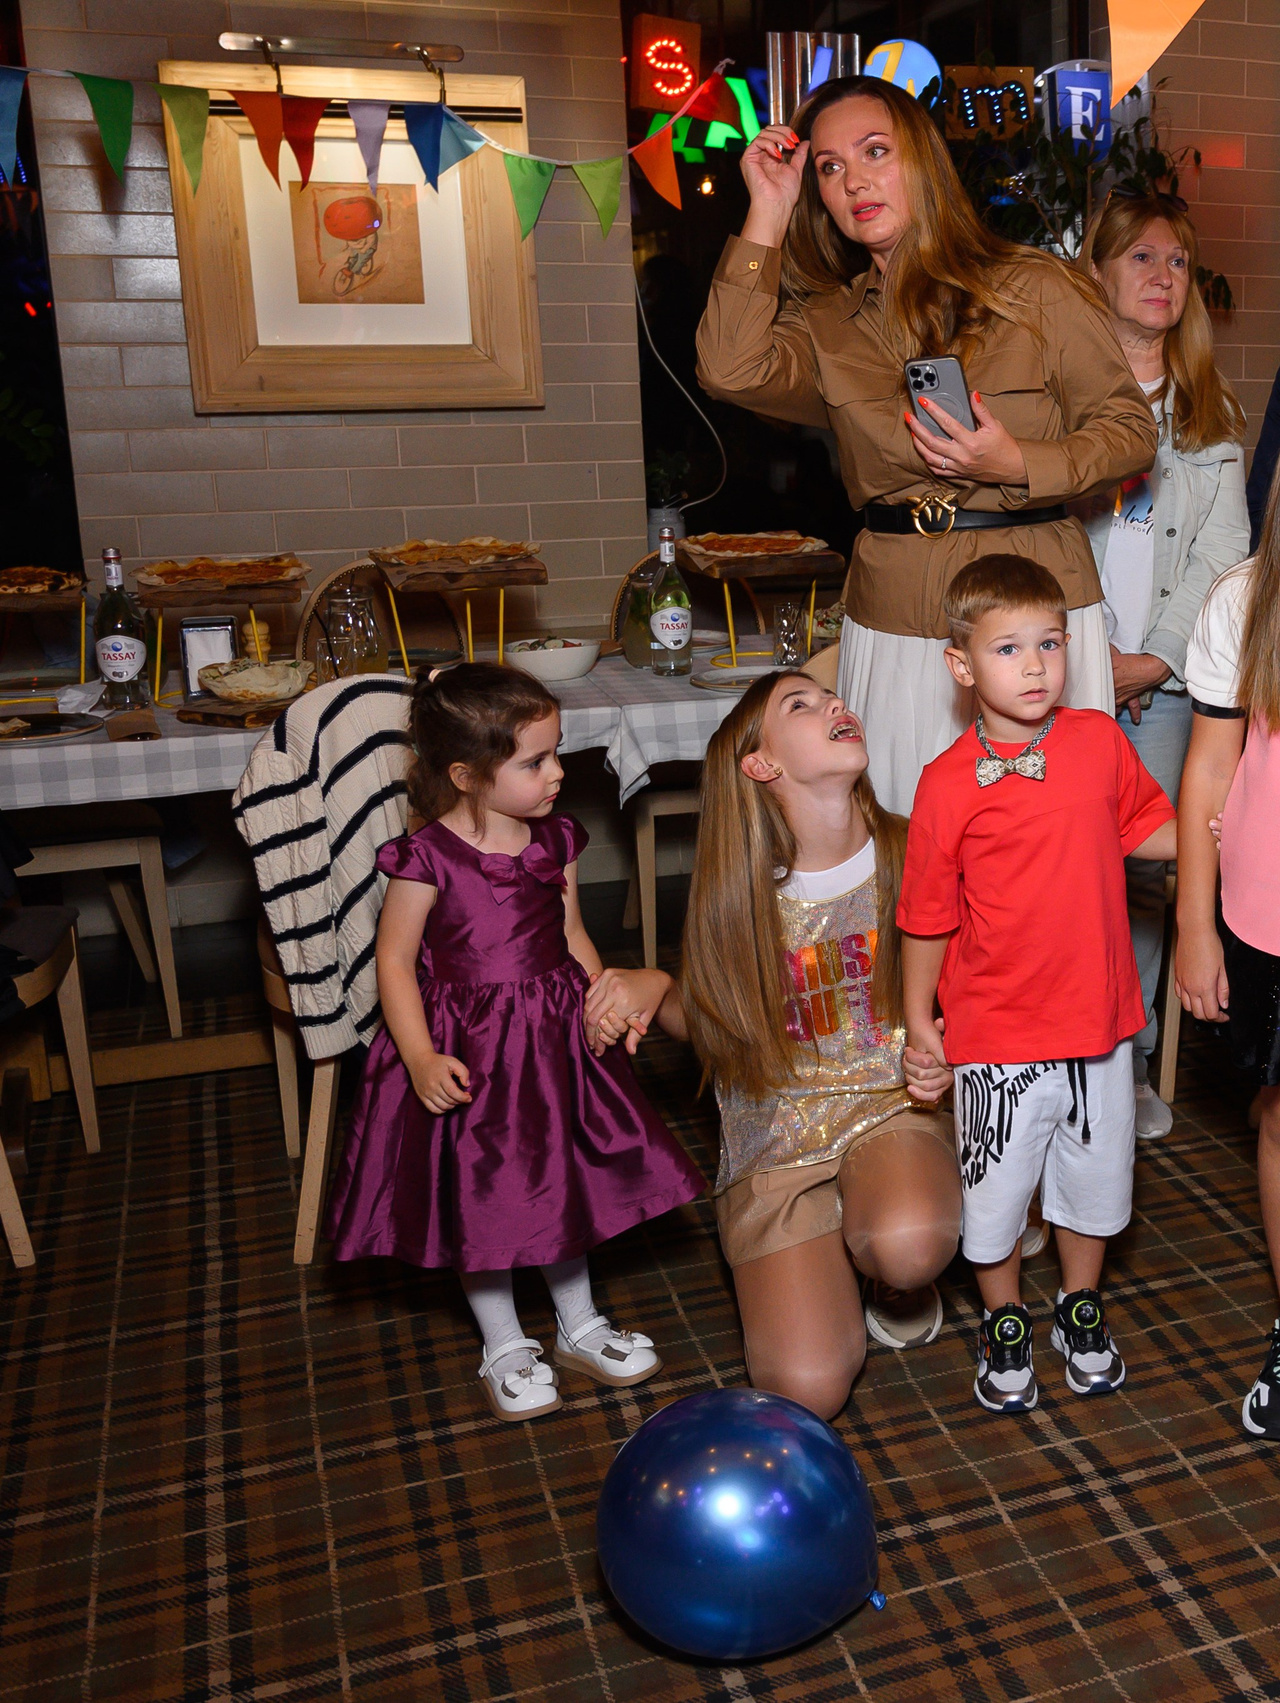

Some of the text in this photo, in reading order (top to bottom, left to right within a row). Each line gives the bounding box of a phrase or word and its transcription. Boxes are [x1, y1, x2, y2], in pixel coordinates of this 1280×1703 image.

[645, 38, 694, 96] S
[1065, 86, 1104, 141] E
[659, 621, 689, 631] TASSAY
[101, 651, 137, 662] TASSAY
[992, 1063, 1041, 1156] THINK
